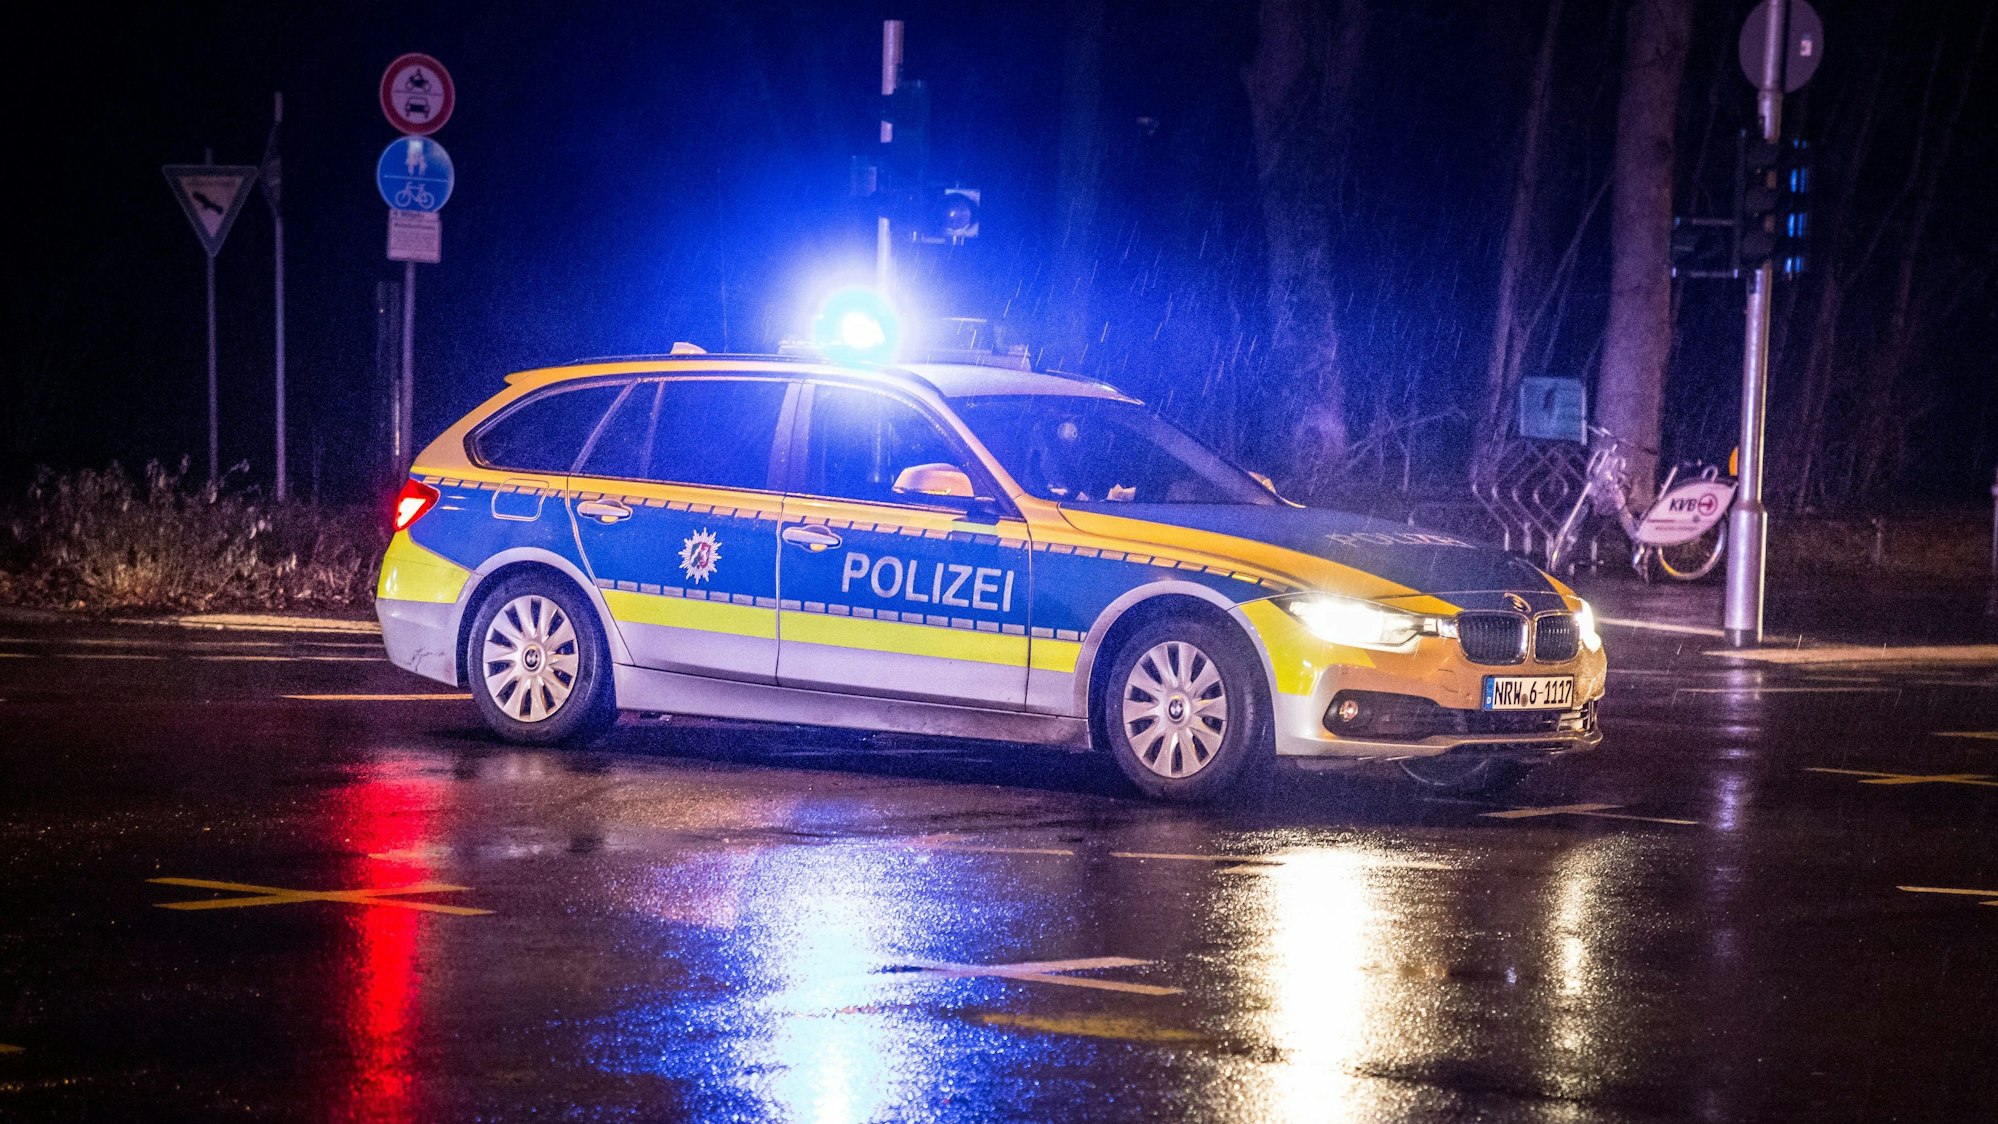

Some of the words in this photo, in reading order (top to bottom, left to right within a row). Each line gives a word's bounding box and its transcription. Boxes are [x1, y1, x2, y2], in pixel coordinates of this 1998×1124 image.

[1669, 498, 1697, 512] KVB
[841, 551, 1015, 612] POLIZEI
[1494, 681, 1522, 705] NRW
[1529, 680, 1572, 704] 6-1117
